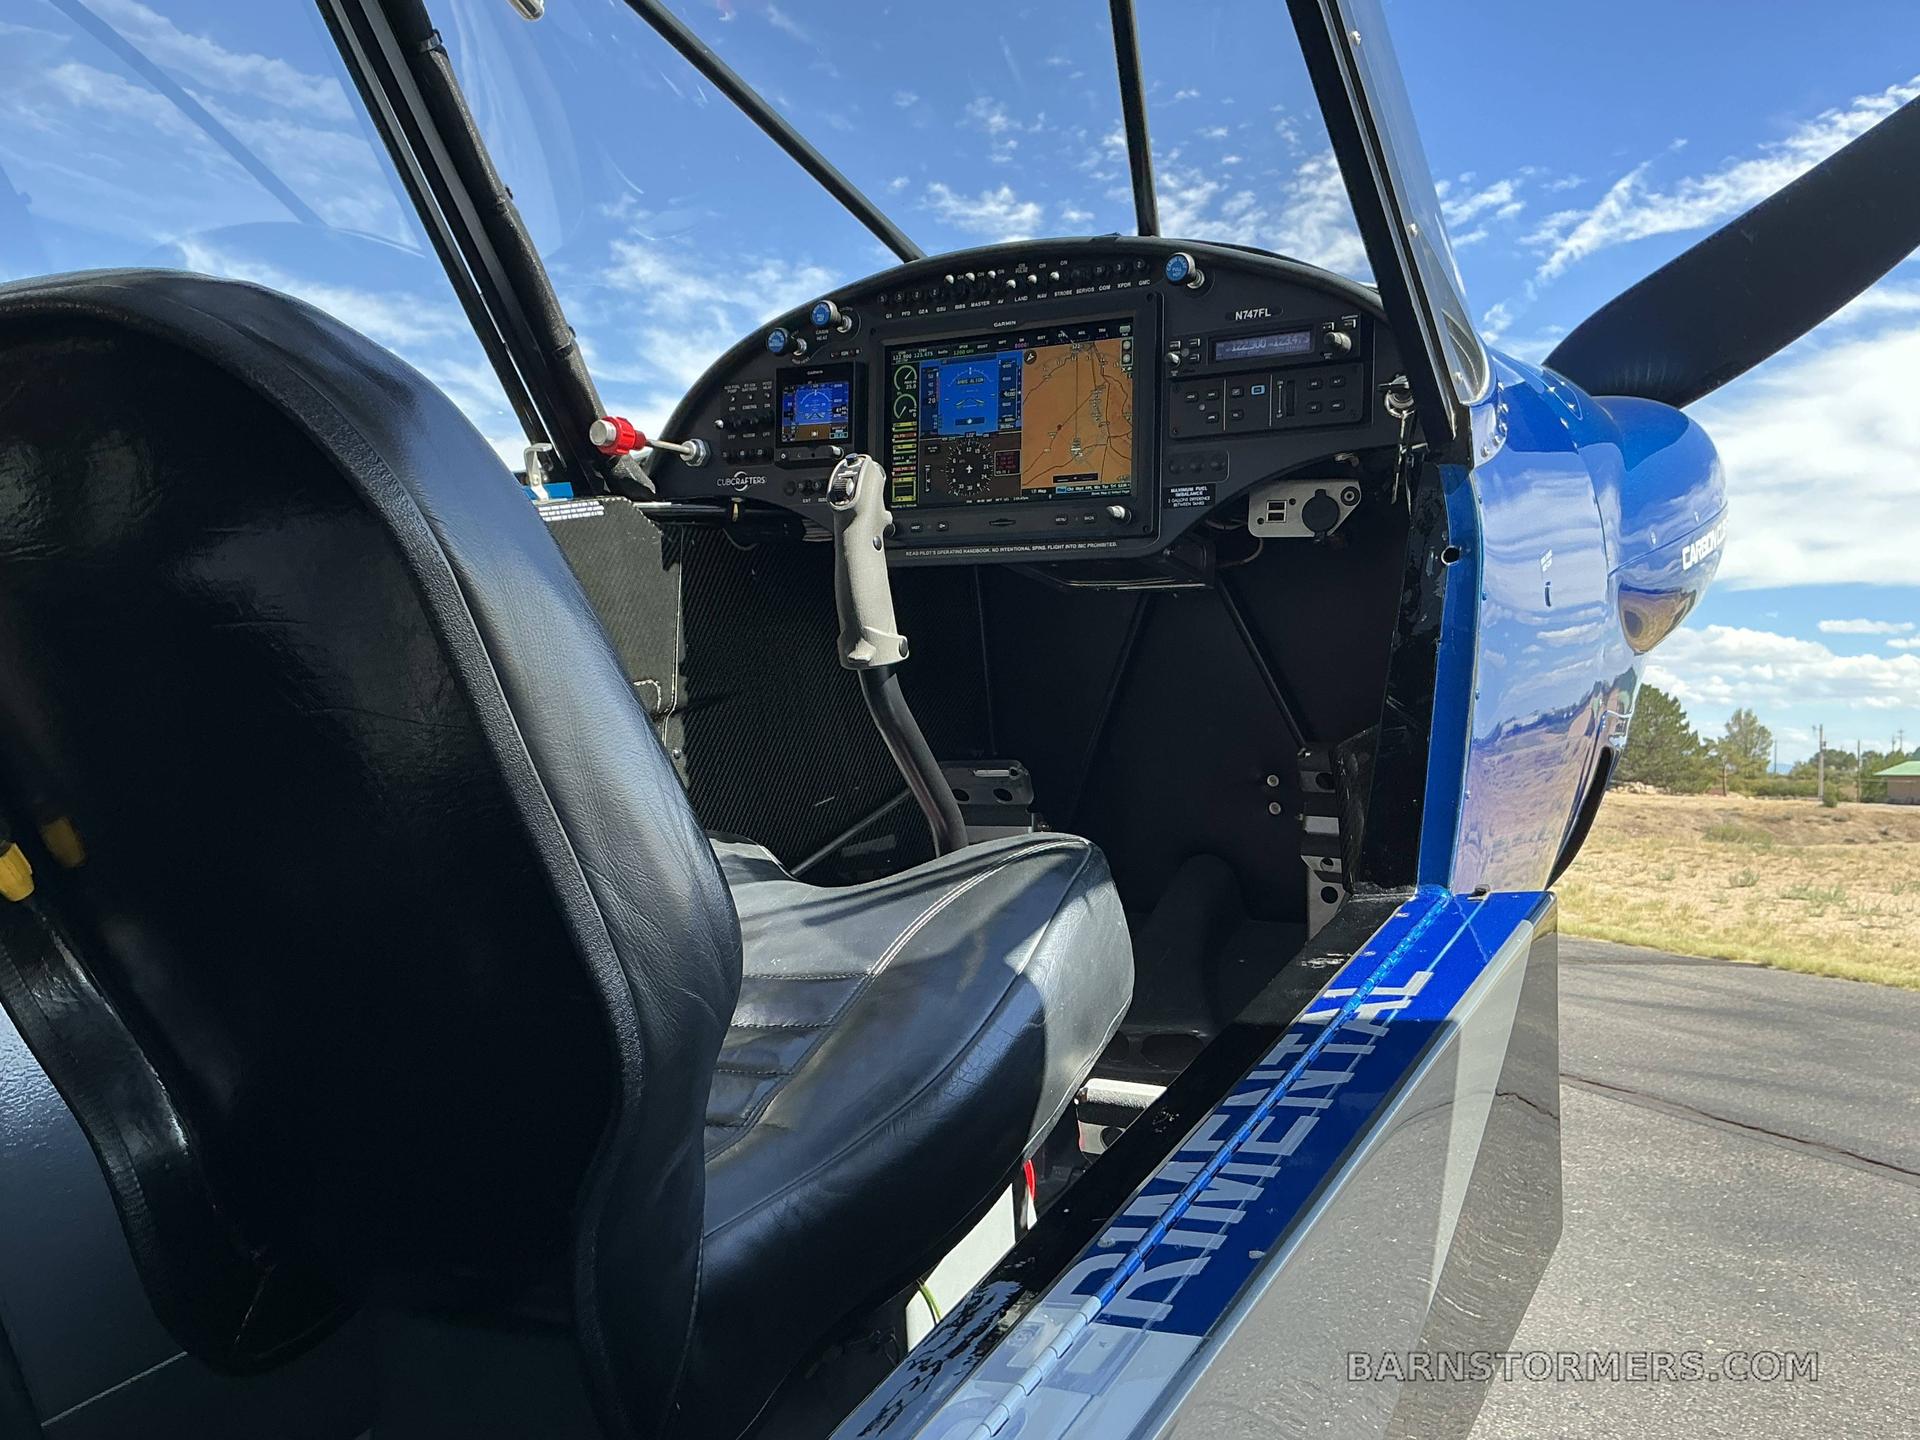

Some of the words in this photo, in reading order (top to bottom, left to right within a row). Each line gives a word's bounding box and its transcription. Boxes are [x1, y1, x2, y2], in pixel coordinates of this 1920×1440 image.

[1235, 308, 1272, 320] N747FL
[717, 476, 766, 486] CUBCRAFTERS
[1682, 528, 1716, 570] CARBON
